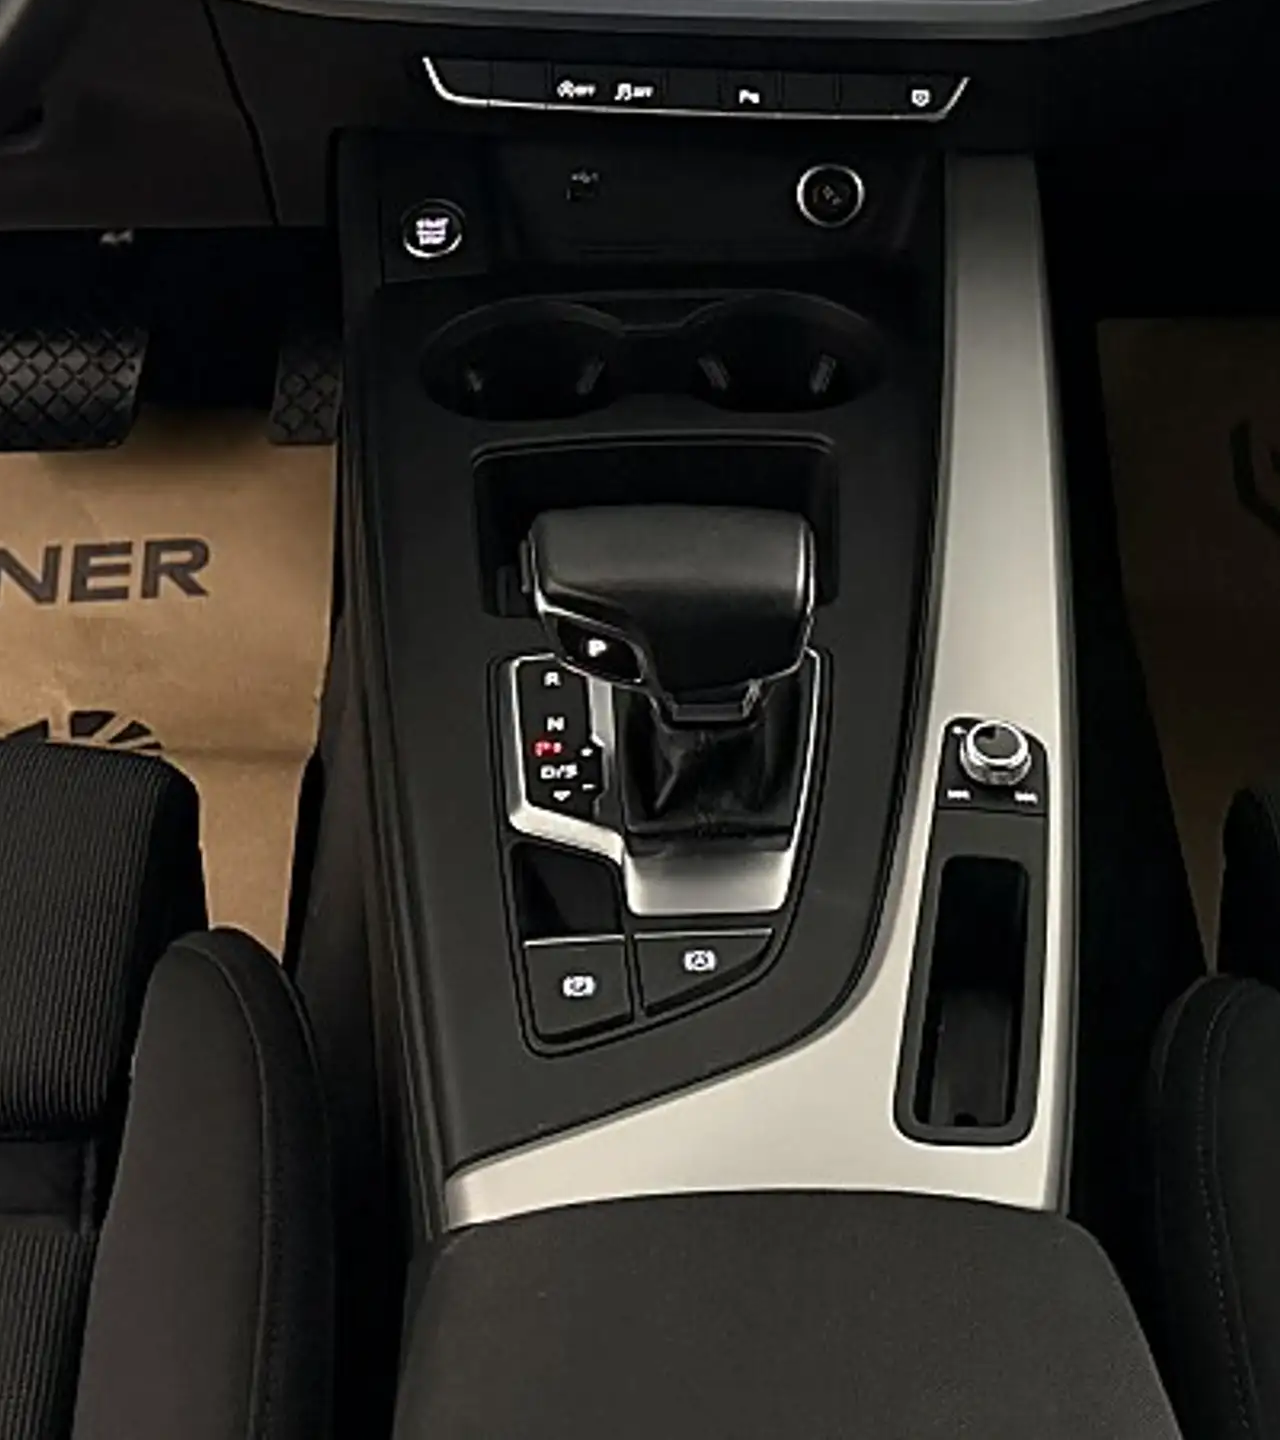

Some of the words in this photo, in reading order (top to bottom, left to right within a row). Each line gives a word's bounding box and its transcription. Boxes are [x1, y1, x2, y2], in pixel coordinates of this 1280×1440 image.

[587, 639, 607, 657] P
[544, 671, 562, 687] R
[546, 716, 565, 732] N
